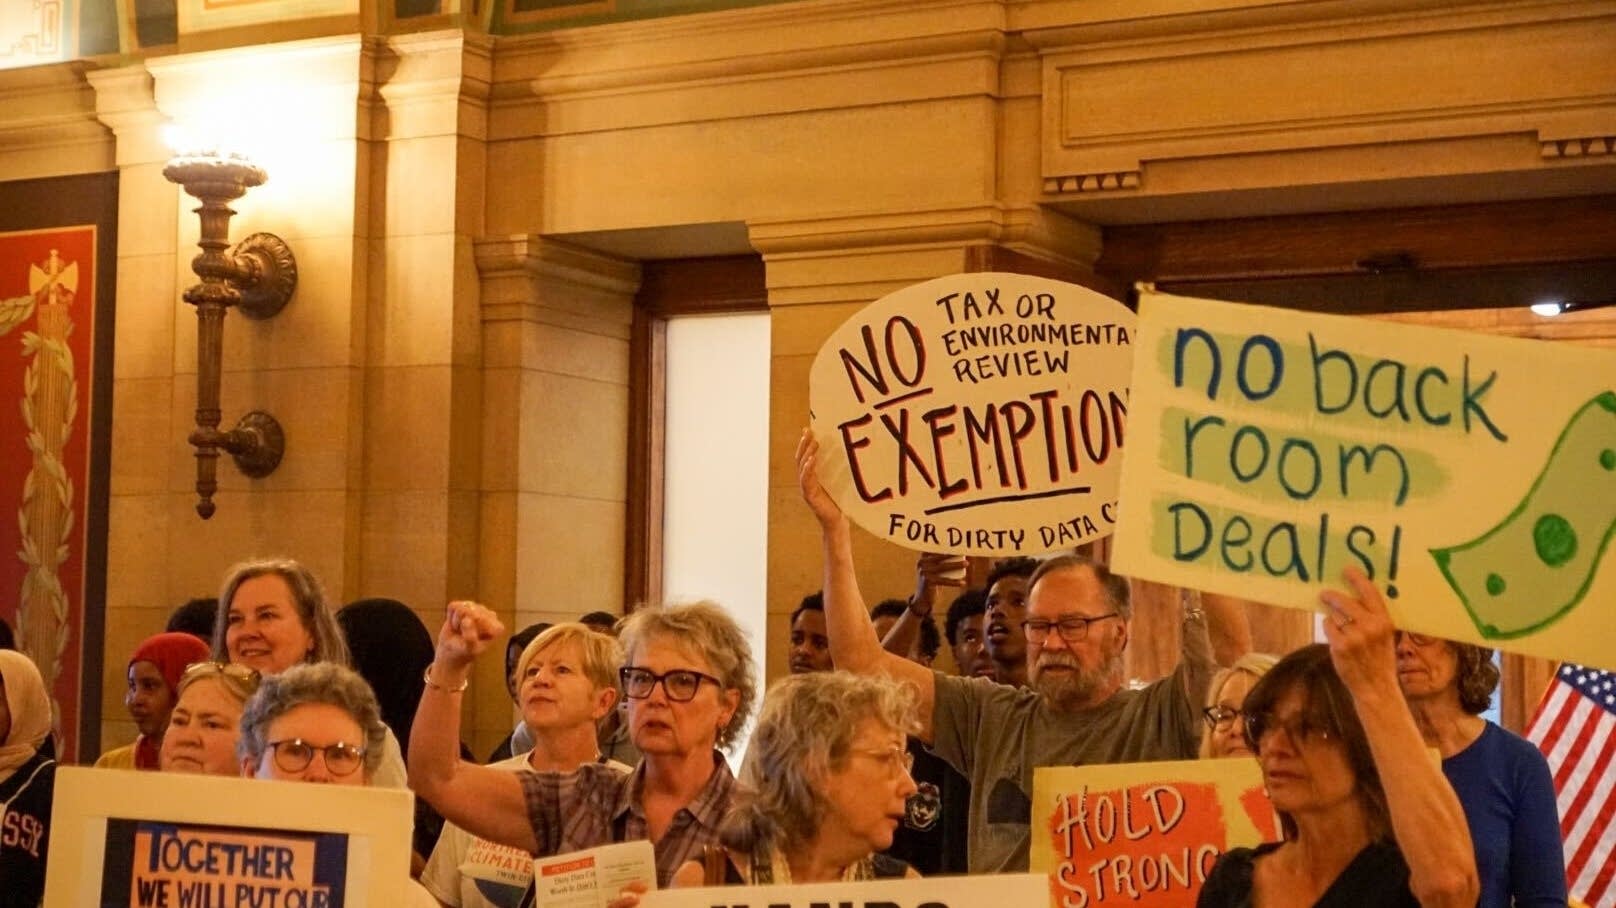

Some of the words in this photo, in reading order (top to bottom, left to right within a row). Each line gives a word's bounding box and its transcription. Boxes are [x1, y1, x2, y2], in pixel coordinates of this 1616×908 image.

[936, 288, 1004, 325] TAX
[1016, 293, 1056, 321] OR
[838, 315, 927, 404] NO
[941, 323, 1134, 356] ENVIRONMENTA
[953, 350, 1070, 384] REVIEW
[1174, 327, 1285, 401] no
[1308, 331, 1508, 442] back
[1184, 415, 1410, 507] room
[889, 513, 939, 545] FOR
[947, 527, 1025, 550] DIRTY
[1039, 515, 1098, 549] DATA
[1168, 501, 1402, 599] Deals!
[1057, 785, 1186, 858] HOLD
[138, 823, 294, 881] TOGETHER
[470, 850, 532, 874] CLIMATE
[137, 876, 171, 908] WE
[236, 884, 281, 908] PUT
